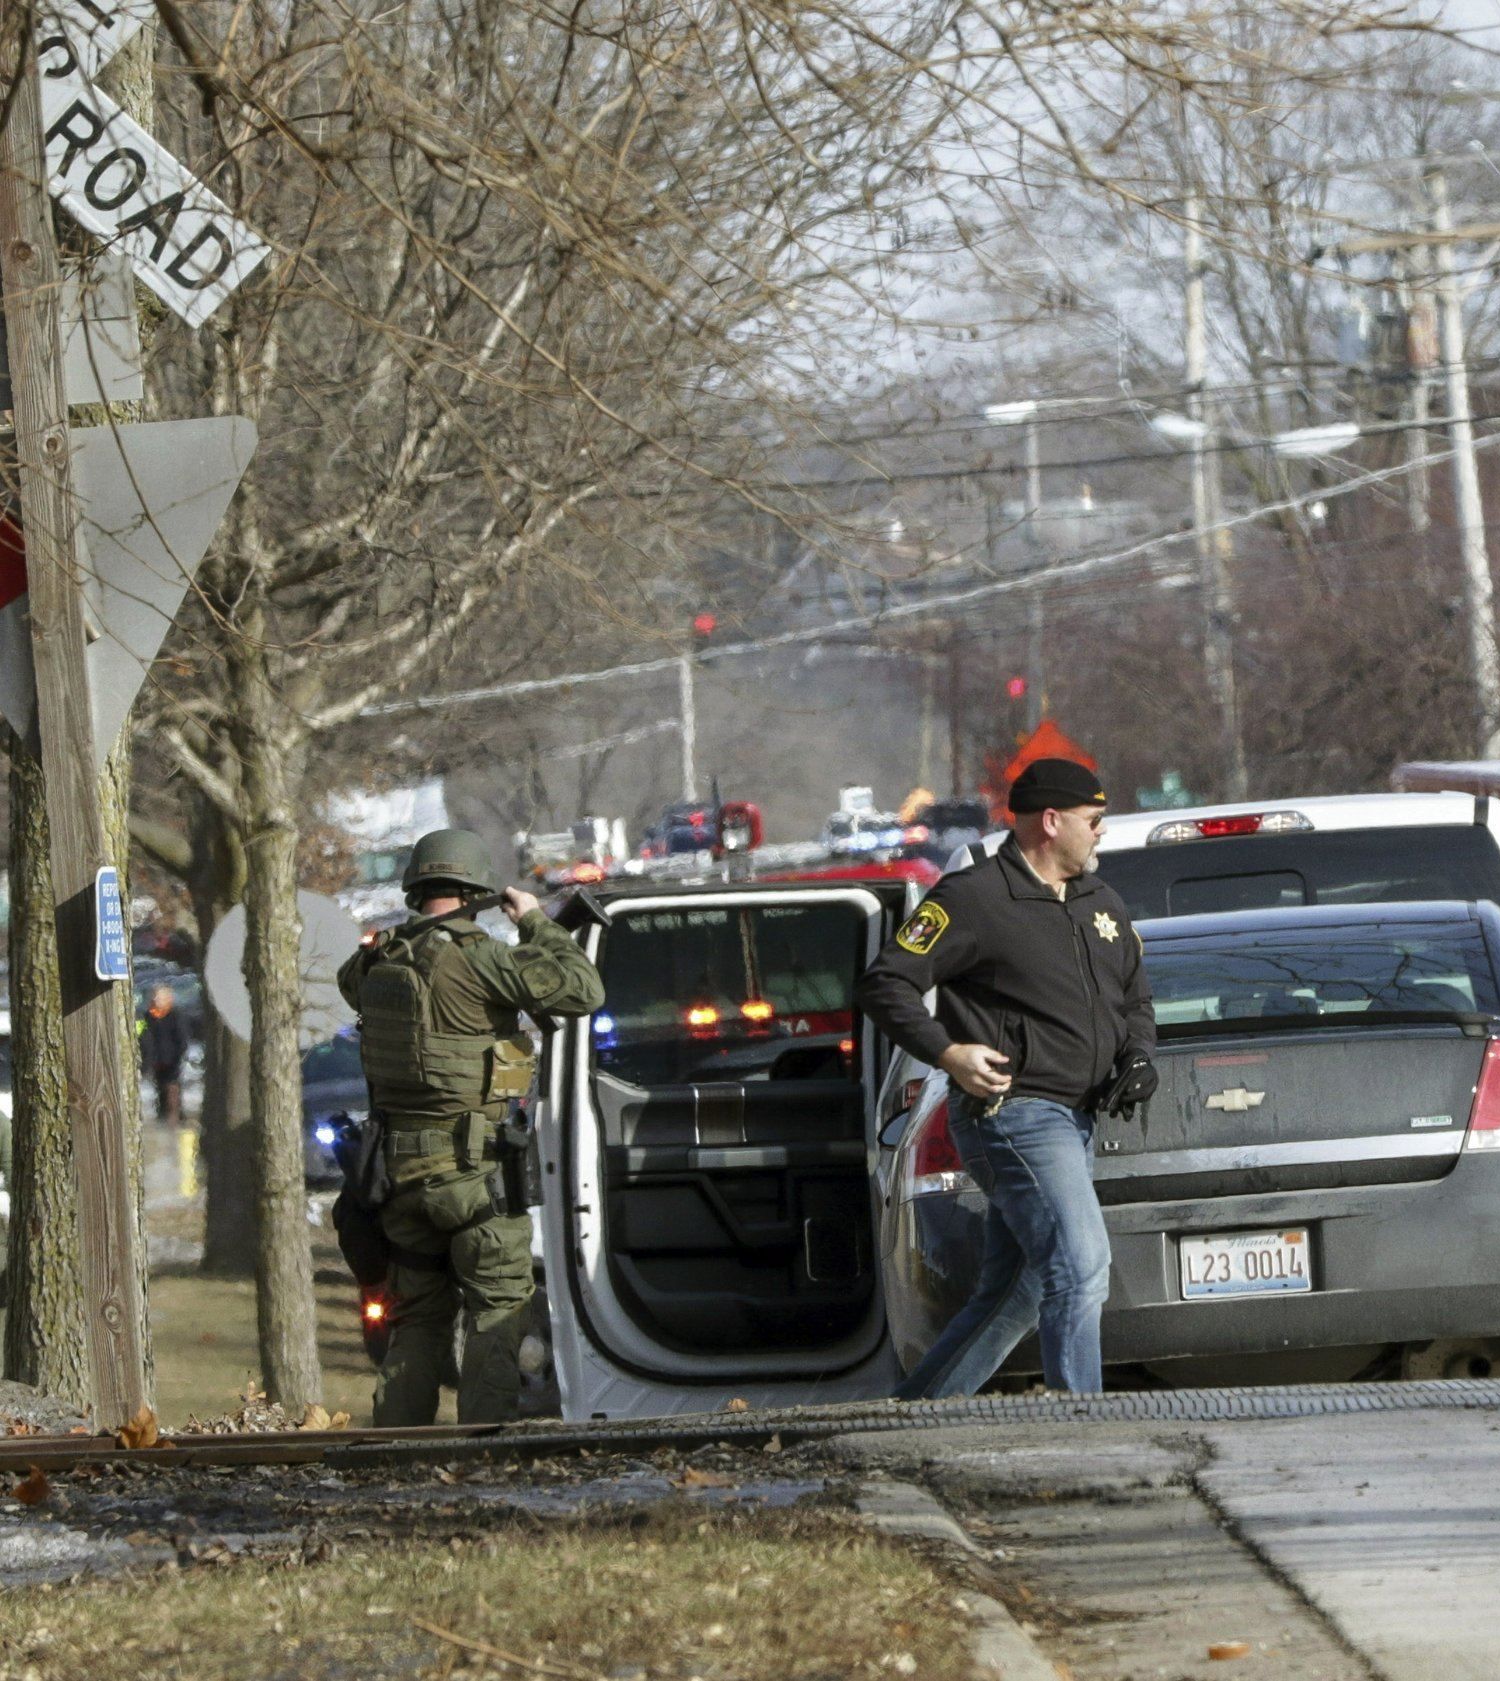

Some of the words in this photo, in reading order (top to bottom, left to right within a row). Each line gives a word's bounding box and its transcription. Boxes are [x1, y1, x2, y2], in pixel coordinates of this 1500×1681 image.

[45, 98, 233, 291] ROAD
[1187, 1253, 1232, 1285] L23
[1244, 1247, 1303, 1281] 0014
